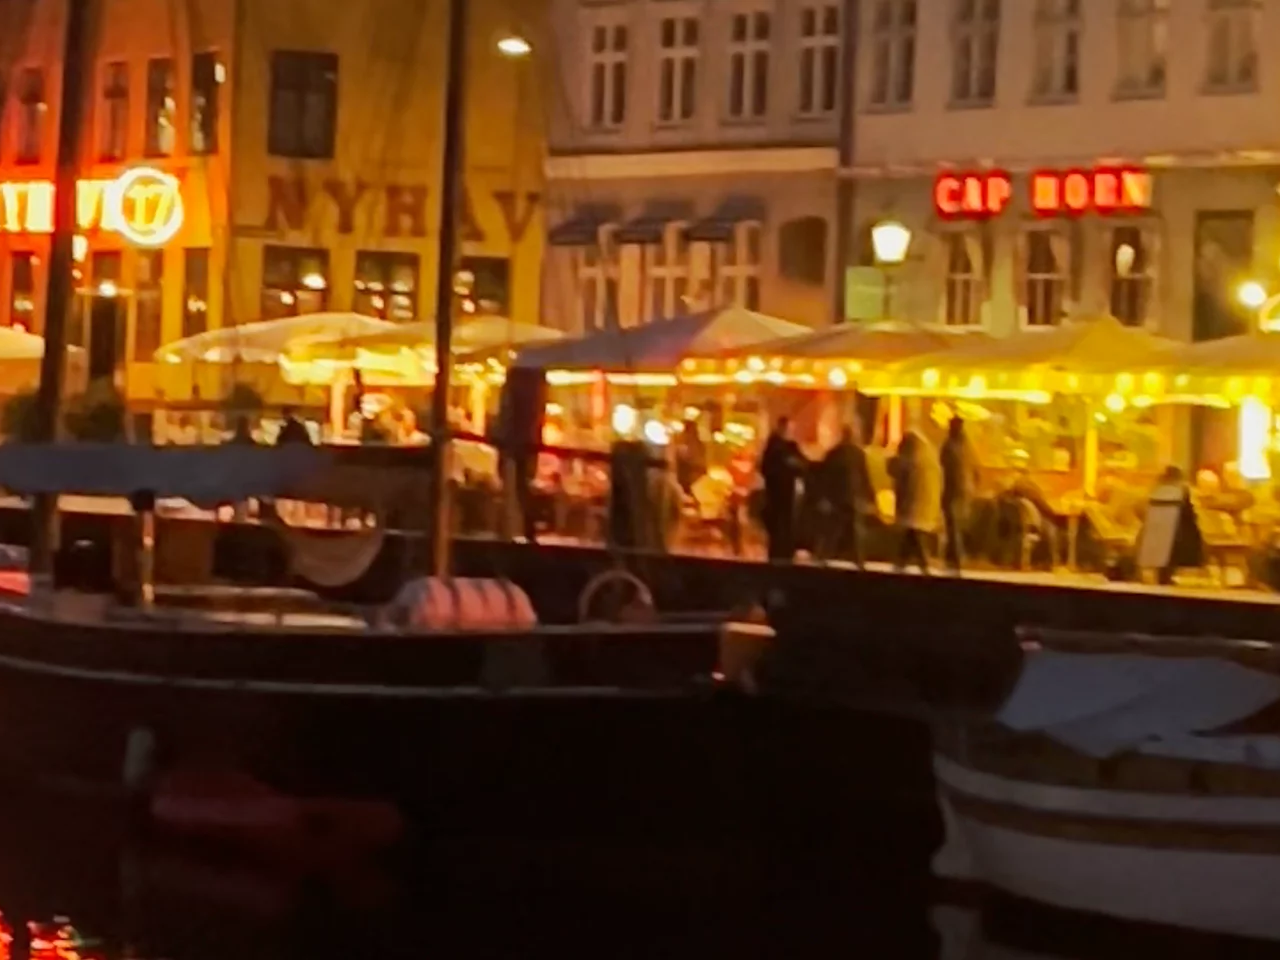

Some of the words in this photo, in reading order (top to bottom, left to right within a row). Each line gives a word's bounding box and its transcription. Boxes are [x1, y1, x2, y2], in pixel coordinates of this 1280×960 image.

[124, 180, 176, 233] 17
[936, 176, 1011, 213] CAP
[1034, 171, 1152, 209] HORN
